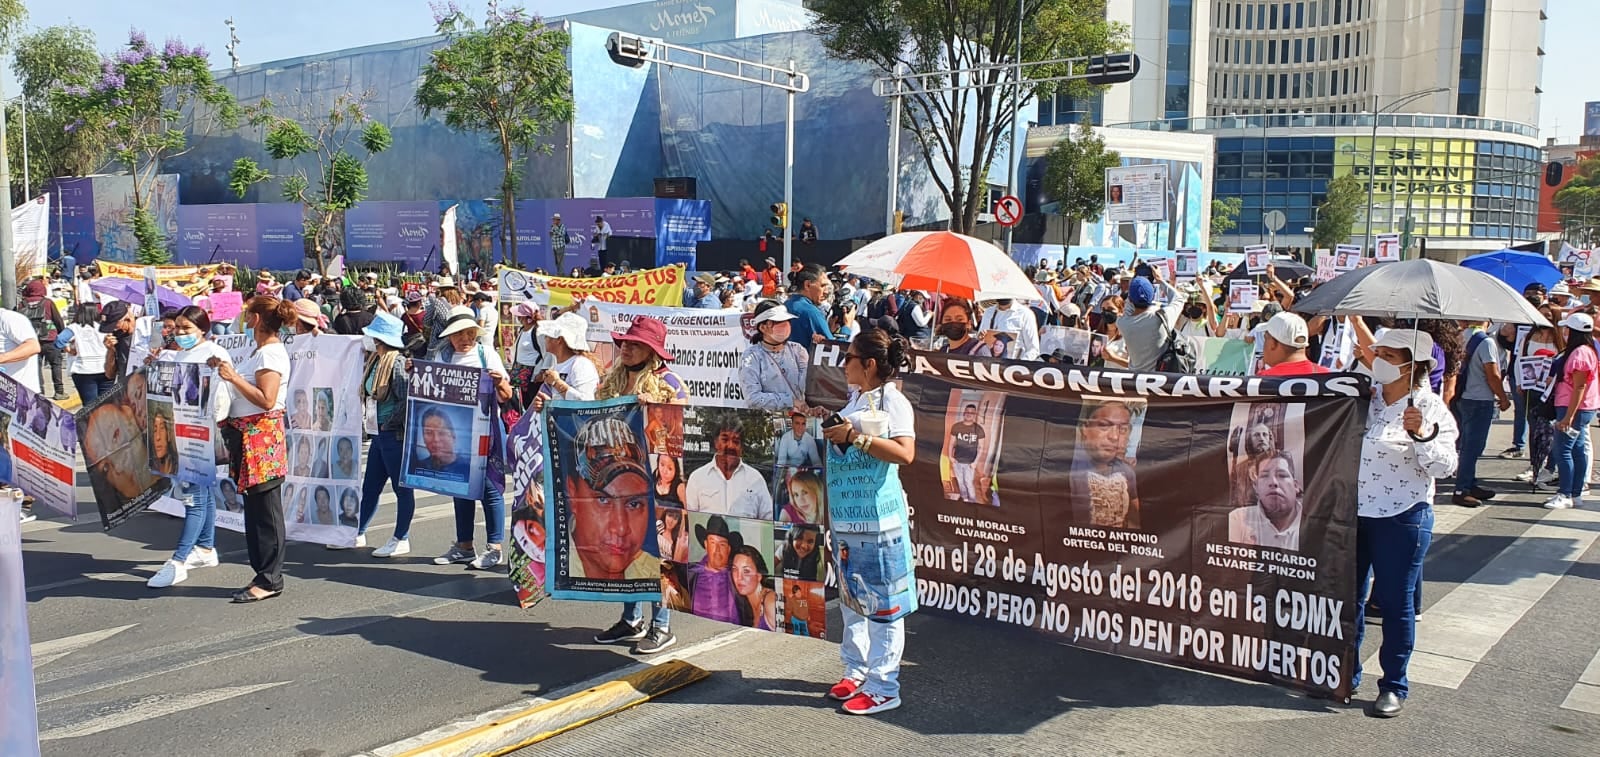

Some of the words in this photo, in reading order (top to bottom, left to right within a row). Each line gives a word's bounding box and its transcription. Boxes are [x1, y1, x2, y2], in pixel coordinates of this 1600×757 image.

[650, 2, 716, 31] Monet
[1388, 149, 1422, 160] SE
[1354, 166, 1459, 178] RENTAN
[644, 268, 677, 286] TUS
[698, 349, 705, 366] a
[435, 367, 479, 380] FAMILIAS
[442, 376, 478, 388] UNIDAS
[947, 358, 1360, 398] ENCONTRARLOS
[460, 387, 477, 396] .org
[557, 491, 567, 576] ENCONTRARLO
[937, 514, 974, 527] EDWUN
[976, 519, 1026, 535] MORALES
[955, 527, 1009, 542] ALVARADO
[1069, 526, 1106, 539] MARCO
[1109, 531, 1158, 544] ANTONIO
[1063, 537, 1105, 551] ORTEGA
[1108, 542, 1128, 553] DEL
[1131, 545, 1164, 559] ROSAL
[1206, 543, 1257, 559] NESTOR
[1261, 550, 1317, 568] RICARDO
[1207, 556, 1265, 572] ALVAREZ
[1268, 564, 1315, 581] PINZON
[951, 542, 968, 573] el
[974, 544, 997, 578] 28
[1002, 548, 1027, 583] de
[1032, 553, 1102, 597] Agosto
[1109, 564, 1141, 602] del
[1148, 569, 1202, 613] 2018
[1209, 587, 1237, 619] en
[1246, 584, 1267, 624] la
[1275, 588, 1343, 640] CDMX
[985, 590, 1036, 627] PERO
[1040, 600, 1070, 633] NO
[1129, 615, 1173, 656] DEN
[1179, 624, 1224, 664] POR
[1231, 633, 1340, 690] MUERTOS
